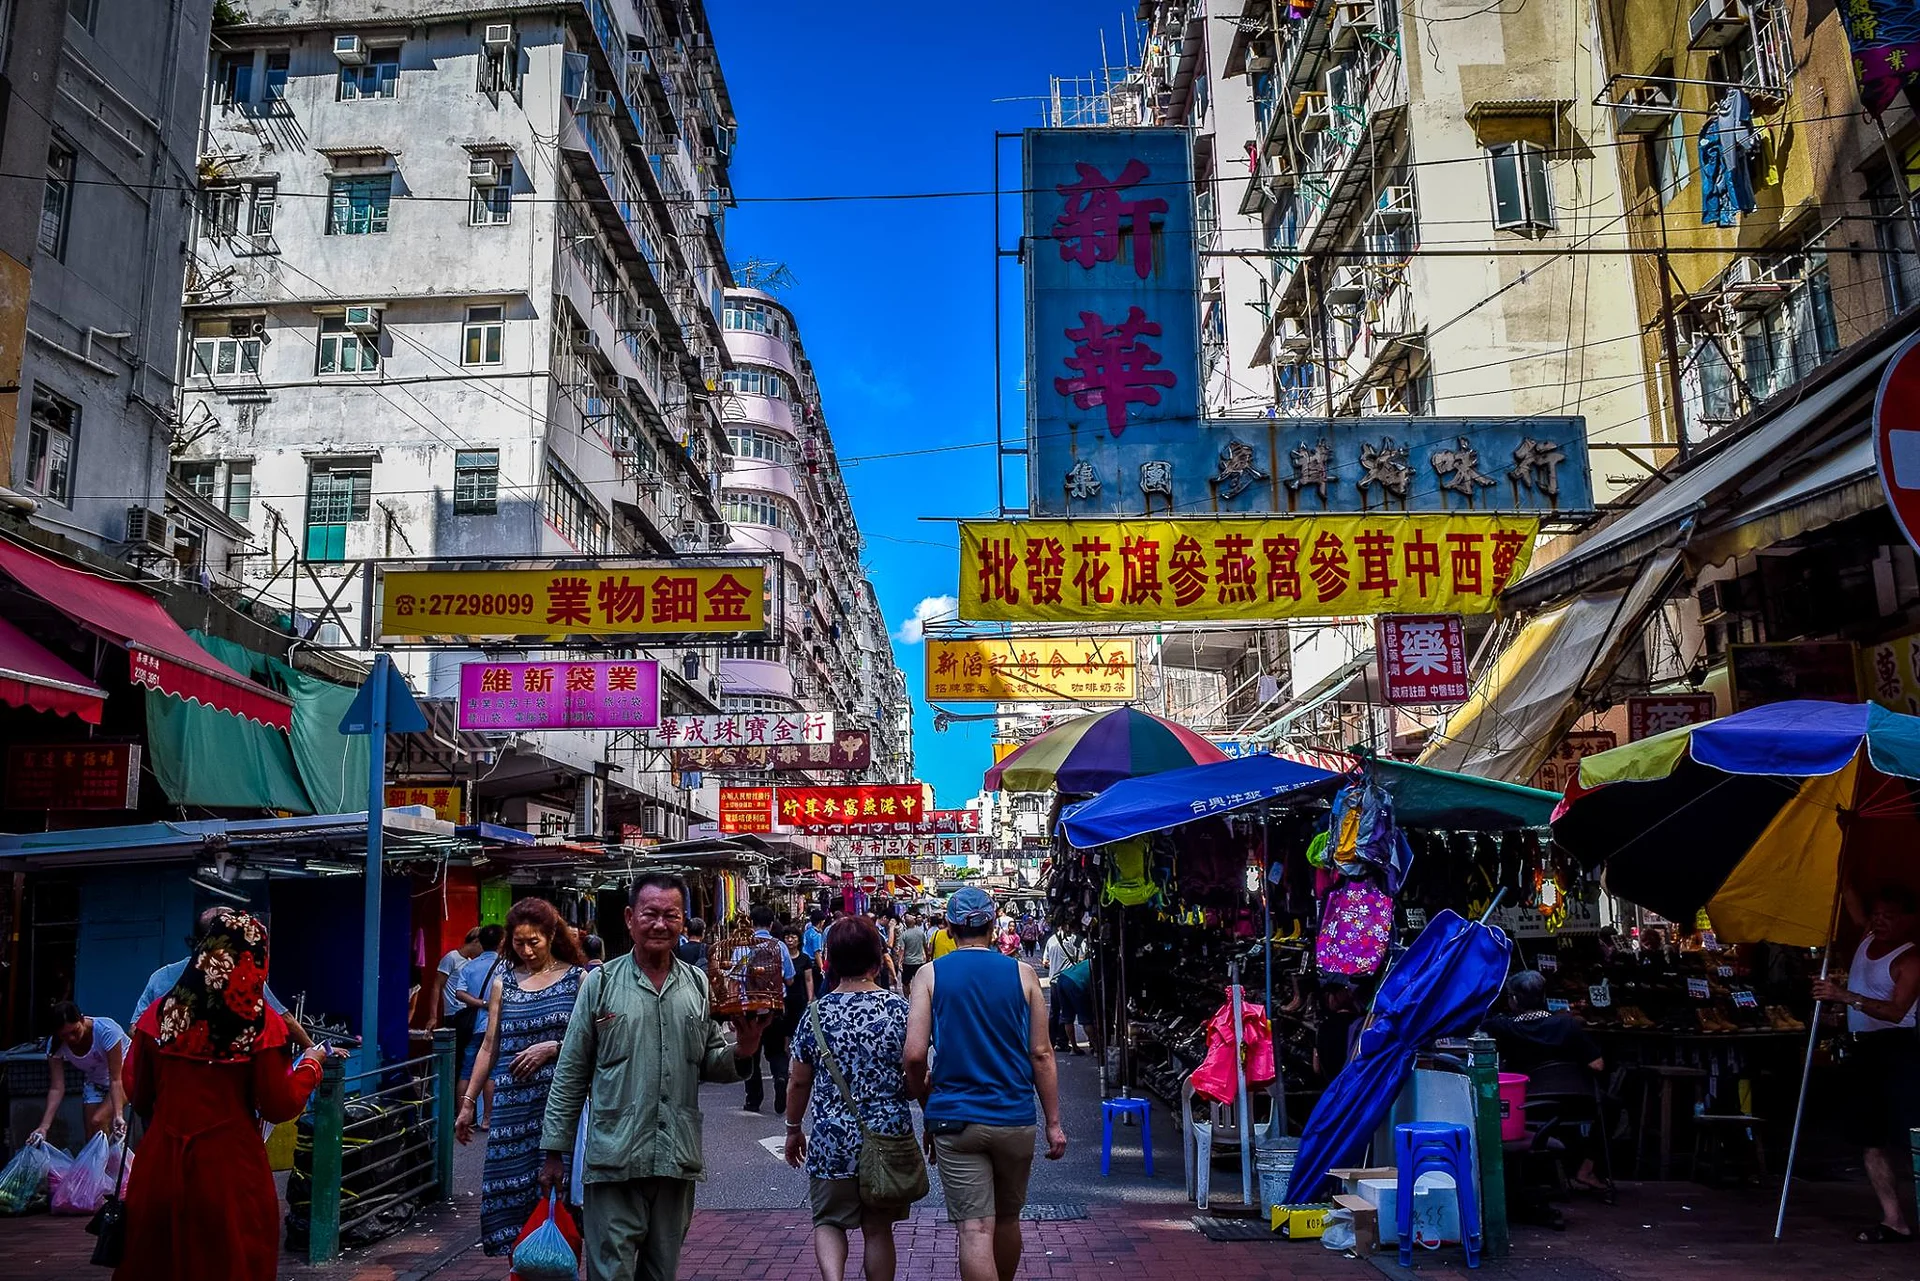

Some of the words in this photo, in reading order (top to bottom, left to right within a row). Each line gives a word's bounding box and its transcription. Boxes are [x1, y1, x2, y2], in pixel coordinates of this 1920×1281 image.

[1052, 158, 1178, 438] 新華
[1400, 621, 1448, 676] 藥
[481, 666, 638, 693] 維新袋業
[656, 714, 827, 745] 華成珠寶金行
